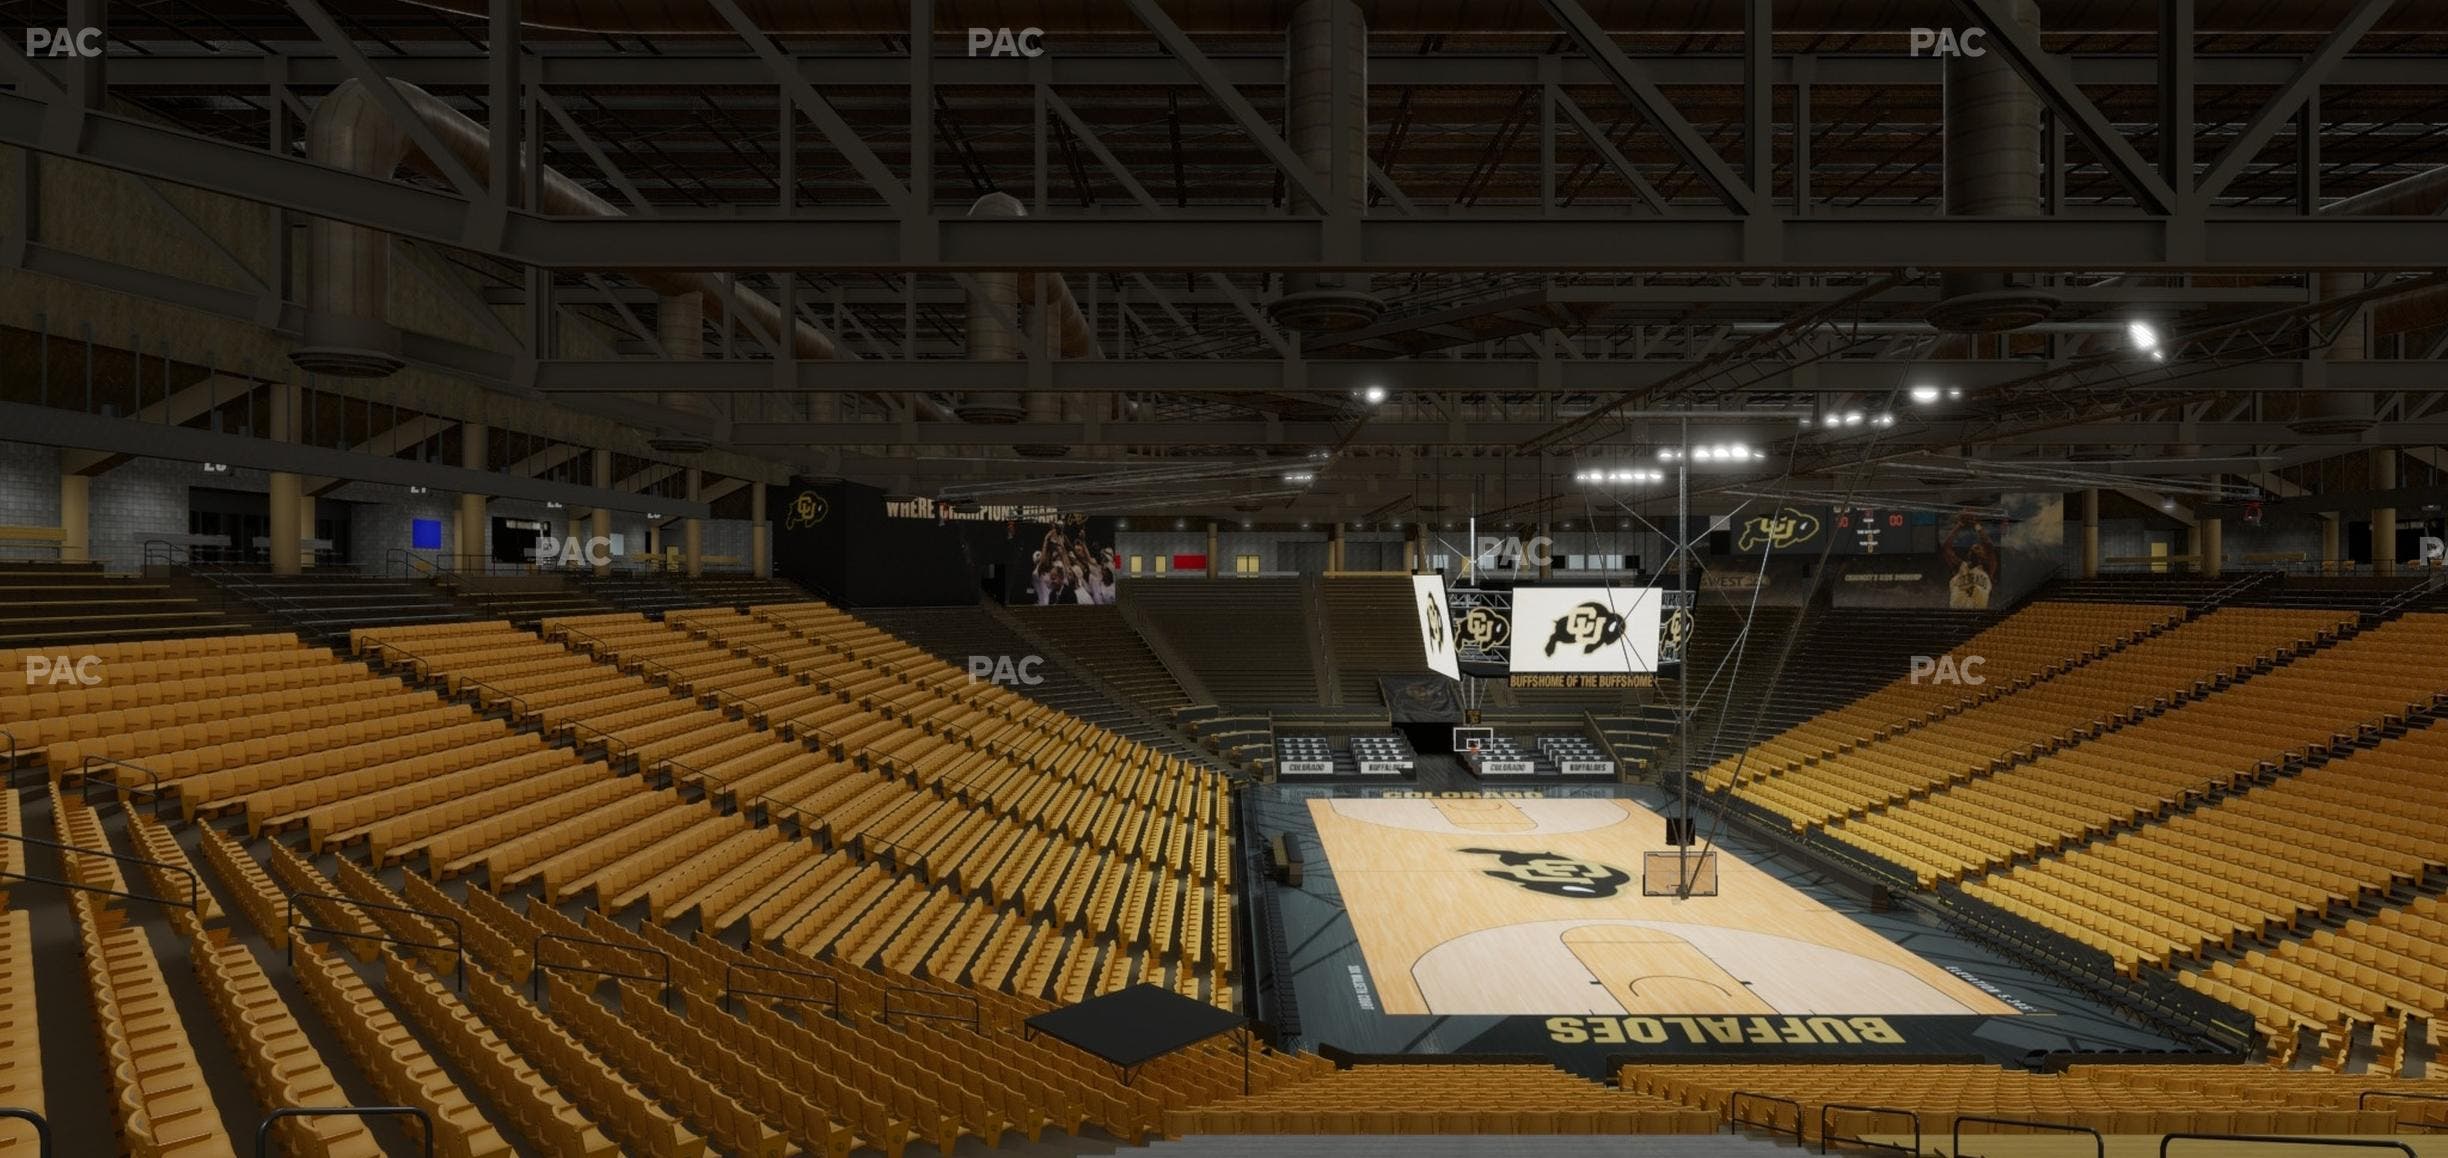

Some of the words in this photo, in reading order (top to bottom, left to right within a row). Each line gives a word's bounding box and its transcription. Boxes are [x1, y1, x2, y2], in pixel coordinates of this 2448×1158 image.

[886, 497, 935, 519] WHERE
[1567, 675, 1578, 687] OF
[1580, 675, 1598, 687] THE
[1382, 791, 1543, 799] COLORADO
[1545, 1016, 1906, 1045] BUFFALOES
